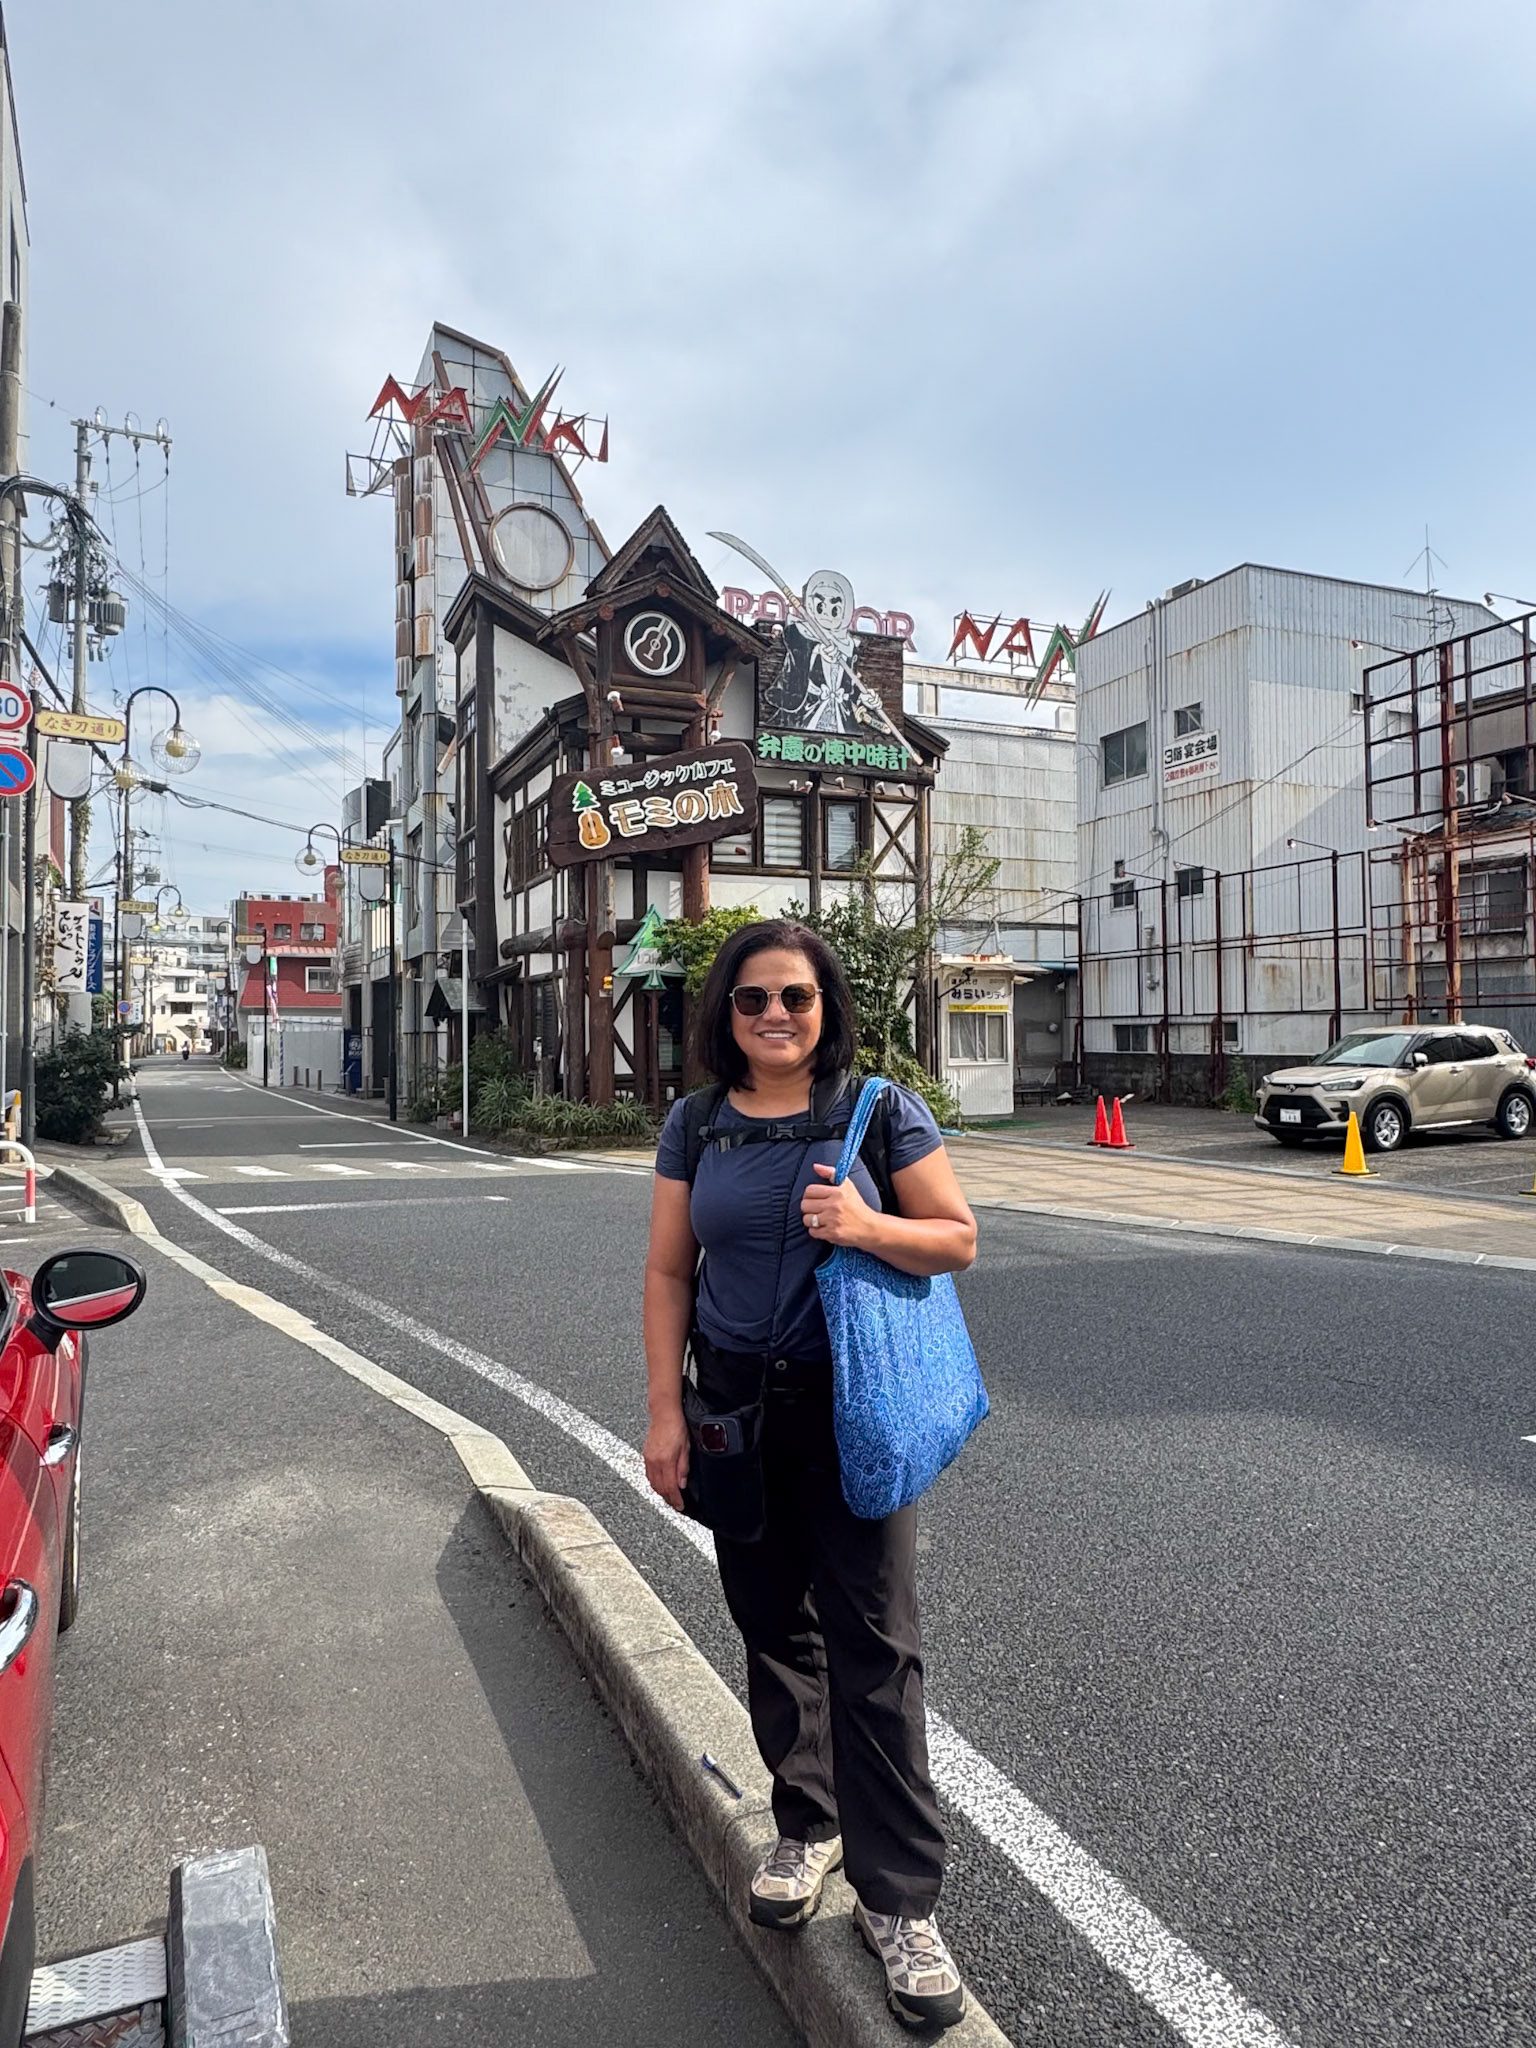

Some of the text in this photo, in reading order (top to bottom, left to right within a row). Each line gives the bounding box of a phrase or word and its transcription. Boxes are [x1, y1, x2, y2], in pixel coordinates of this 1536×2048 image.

[721, 585, 918, 653] PAOR
[0, 697, 18, 717] 0
[45, 716, 118, 737] なぎ刀通り
[757, 733, 910, 771] 弁慶の懐中時計
[600, 758, 736, 796] ミュージックカフェ
[609, 780, 744, 837] モミの木
[345, 851, 386, 861] なぎ刀通り
